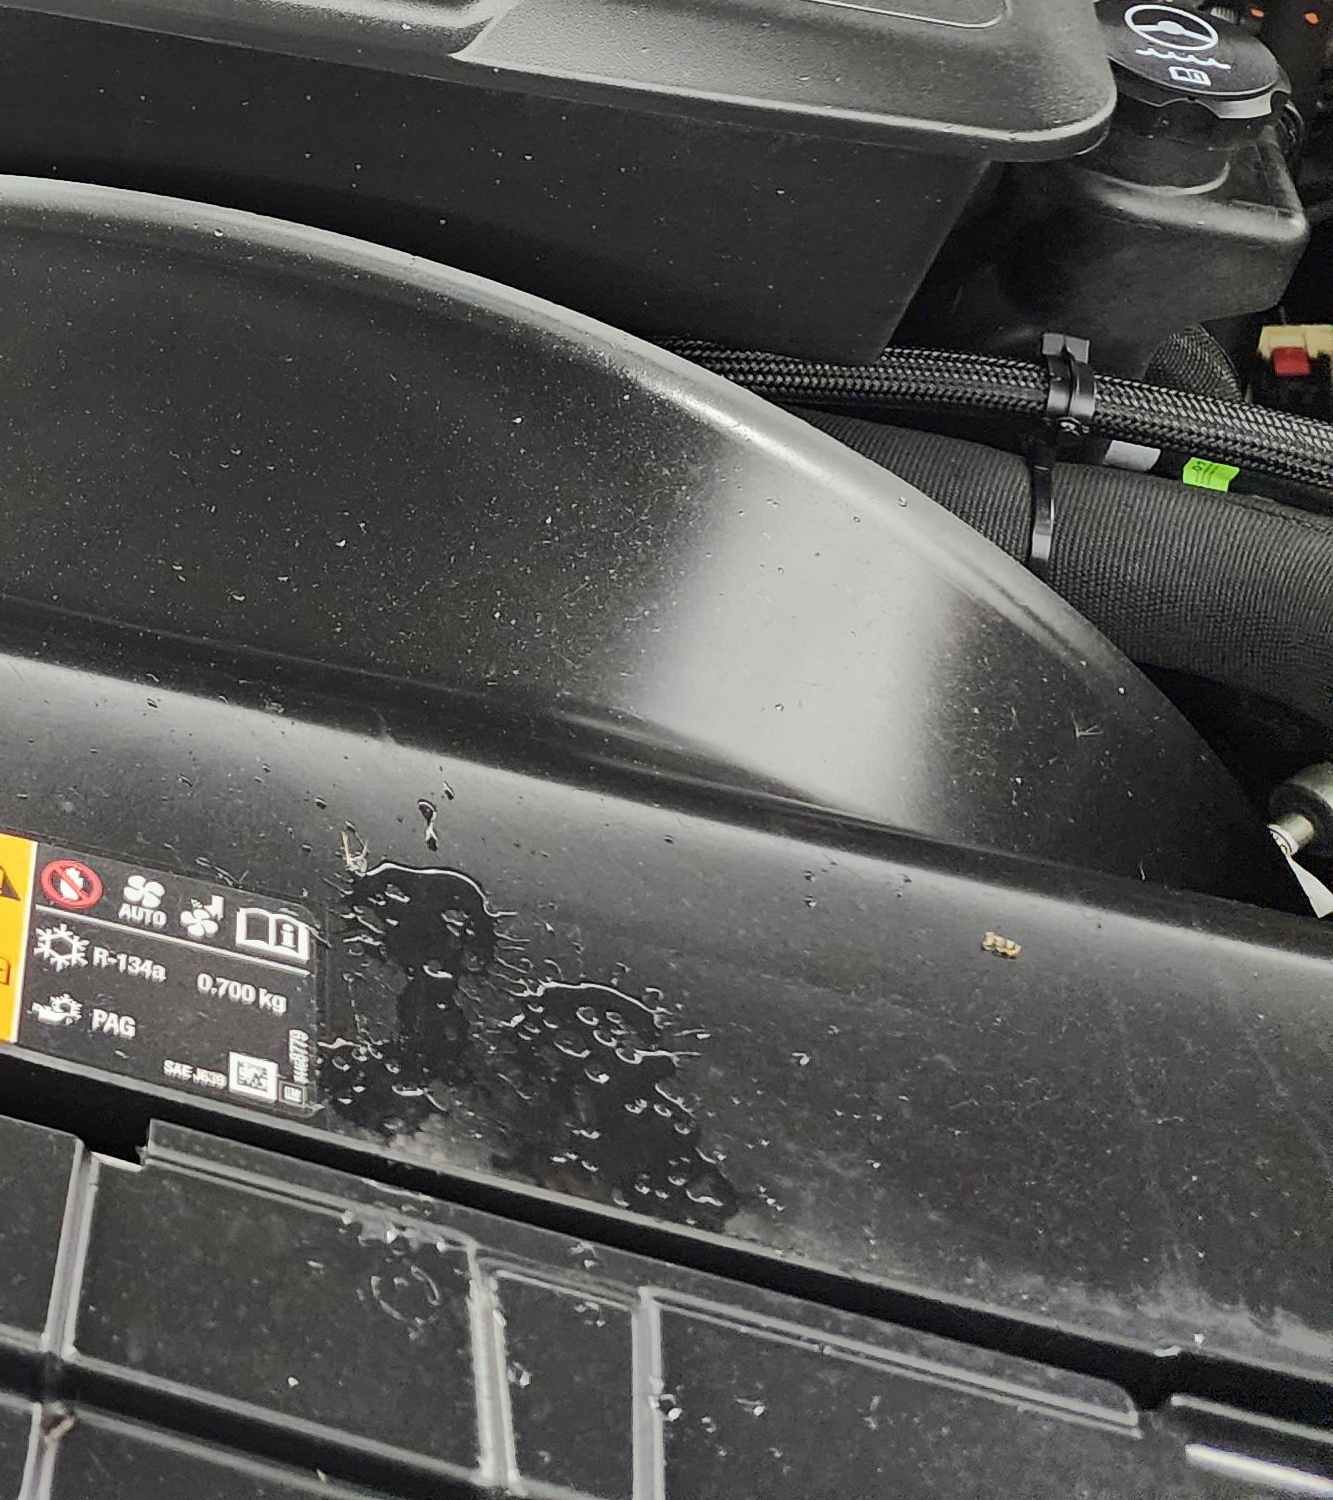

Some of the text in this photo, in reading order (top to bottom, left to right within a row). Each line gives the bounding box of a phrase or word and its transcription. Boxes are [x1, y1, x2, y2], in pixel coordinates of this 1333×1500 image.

[118, 903, 167, 927] AUTO
[93, 946, 167, 982] R-134a
[258, 987, 287, 1015] kg
[92, 1008, 136, 1039] PAG
[163, 1059, 193, 1081] SAE
